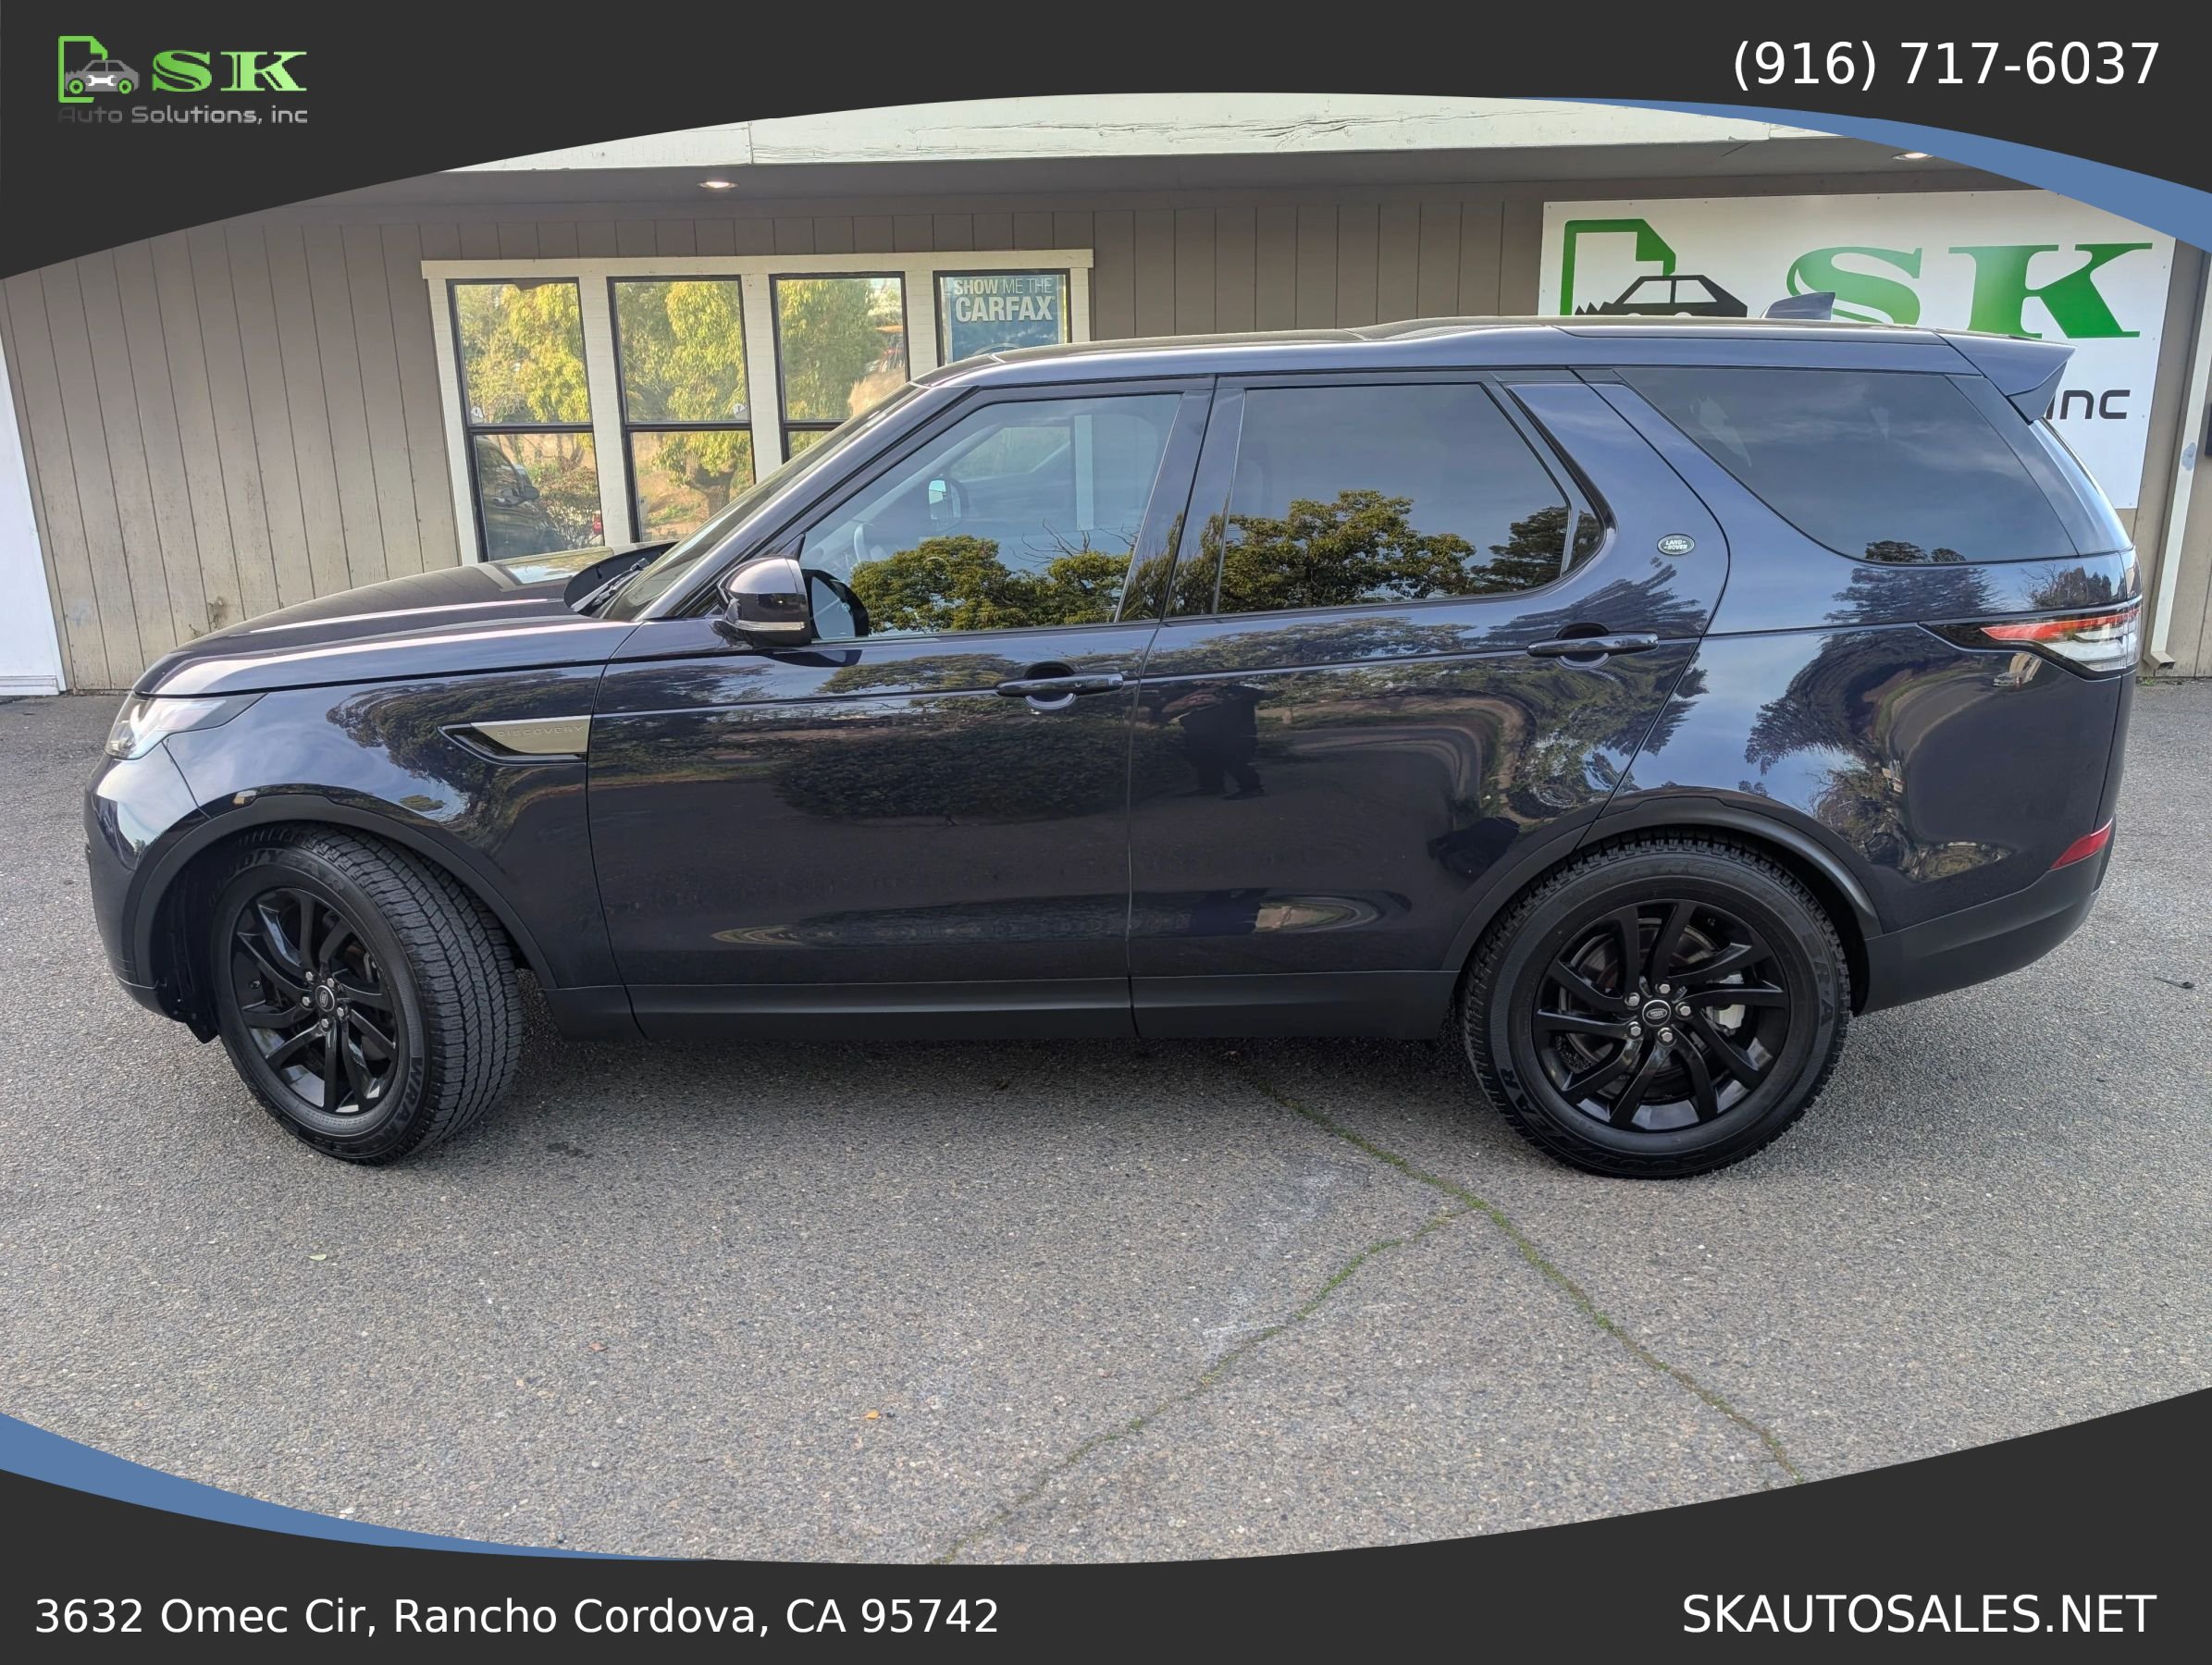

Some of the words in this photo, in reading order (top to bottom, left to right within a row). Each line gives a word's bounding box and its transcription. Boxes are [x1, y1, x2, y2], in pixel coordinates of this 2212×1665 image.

[954, 278, 998, 295] SHOW
[1003, 278, 1023, 294] ME
[1026, 278, 1052, 293] THE
[1786, 242, 2153, 339] SK
[956, 296, 1053, 322] CARFAX
[497, 725, 583, 737] DISCOVERY
